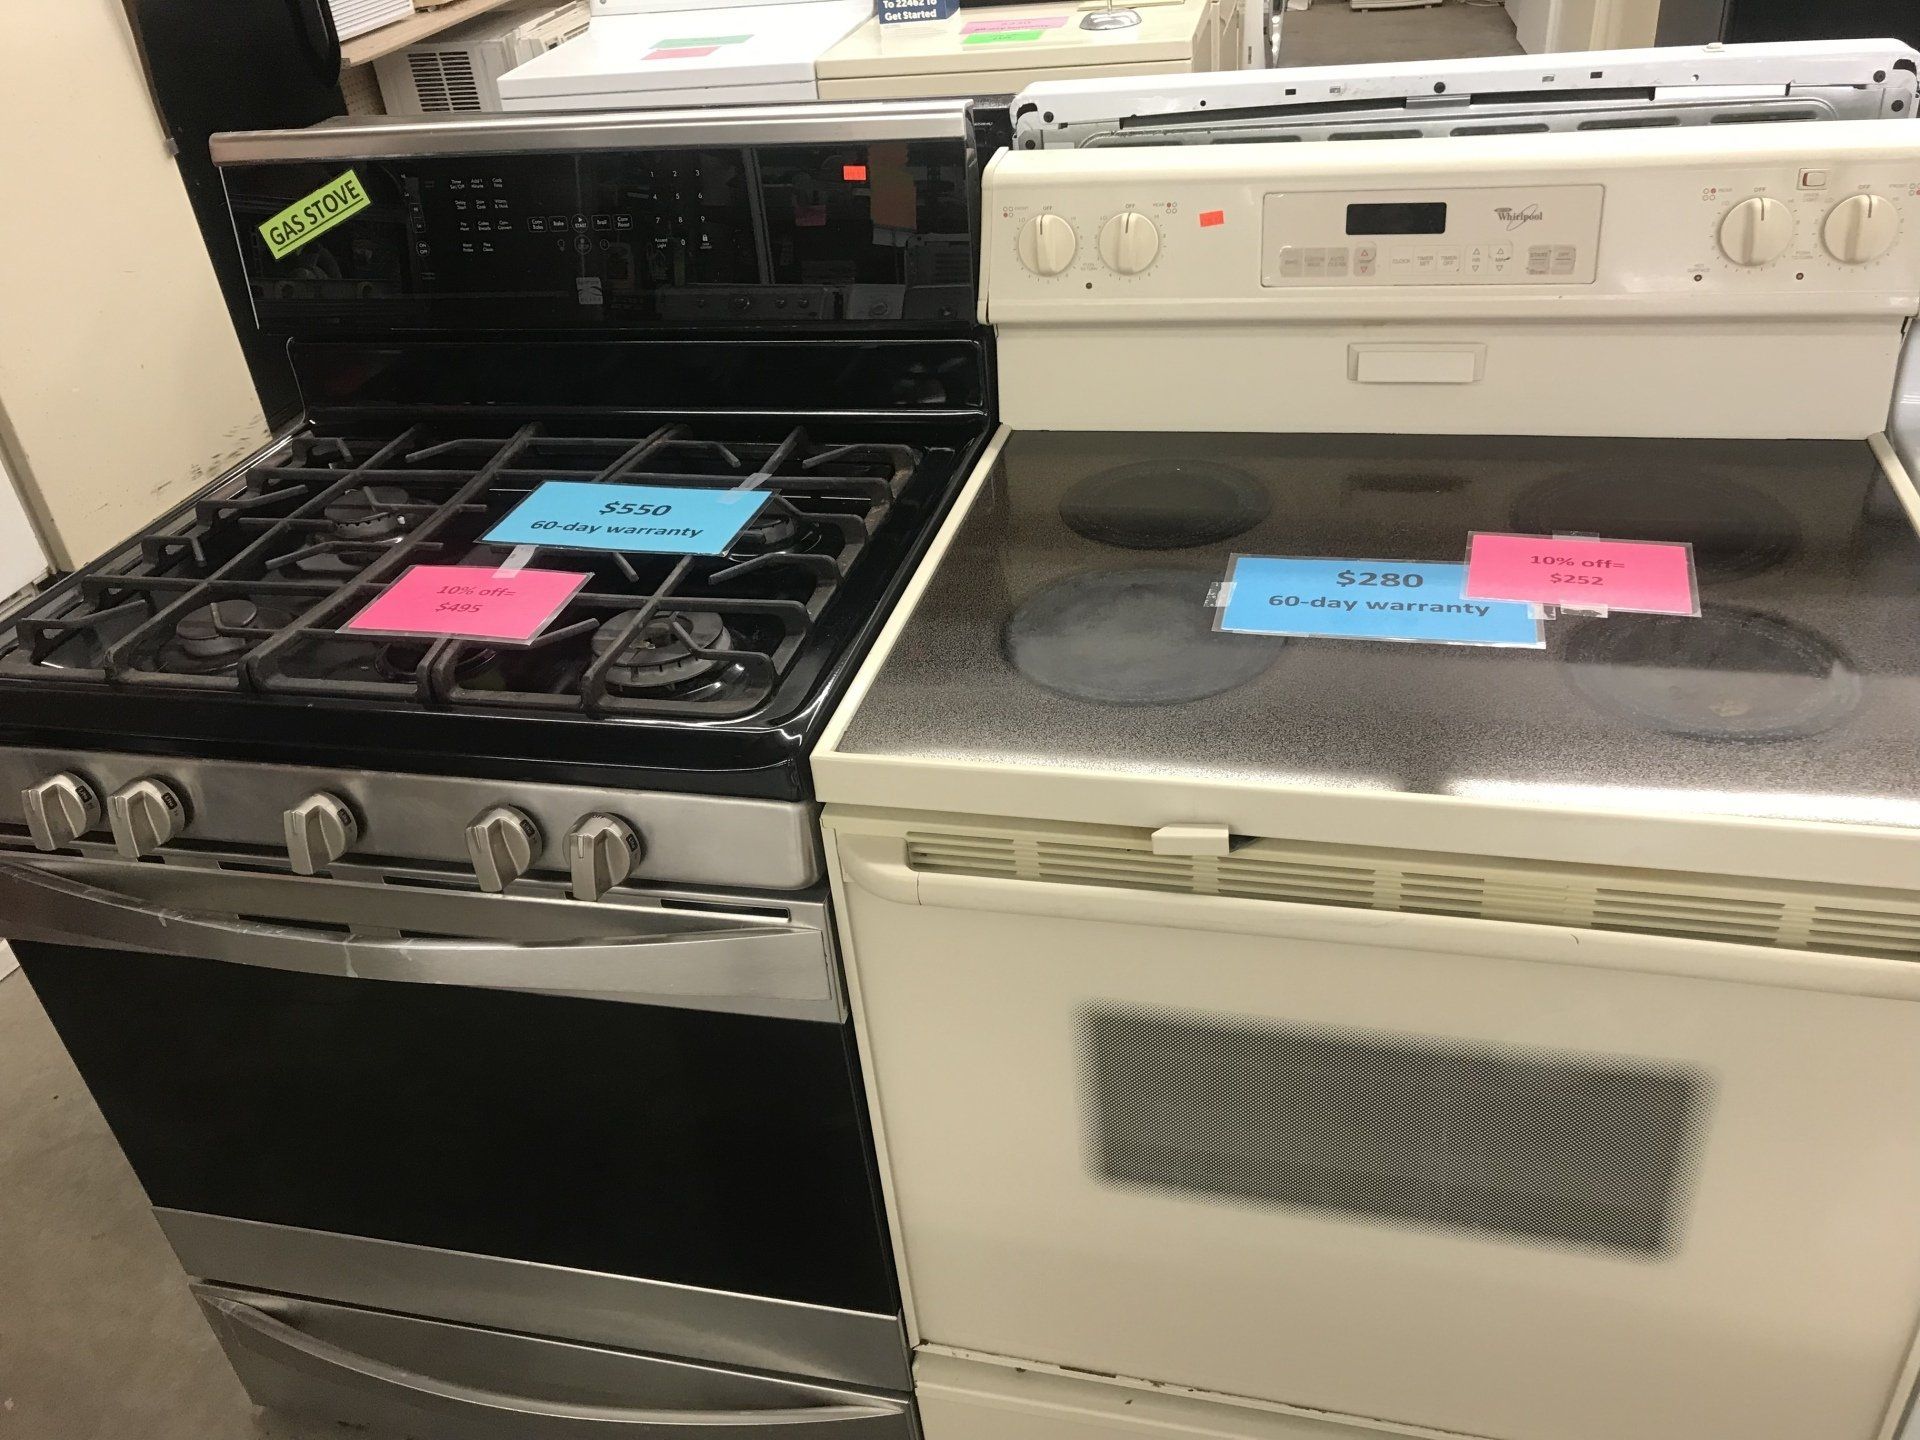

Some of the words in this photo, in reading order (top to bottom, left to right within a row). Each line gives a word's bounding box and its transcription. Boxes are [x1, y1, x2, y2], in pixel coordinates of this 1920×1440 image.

[883, 0, 895, 8] To
[885, 12, 902, 21] Get
[903, 9, 937, 20] Started
[269, 214, 306, 246] GAS
[303, 179, 361, 226] STOVE
[1497, 211, 1543, 223] Whirlpool
[599, 500, 673, 517] $550
[530, 519, 602, 535] 60-day
[606, 524, 703, 540] warranty
[1529, 555, 1575, 567] 10%
[1581, 557, 1626, 569] off=
[1336, 569, 1424, 589] $280
[1549, 572, 1605, 587] $252
[435, 585, 477, 596] 10%
[434, 601, 484, 613] $495
[1268, 595, 1359, 613] 60-day
[1366, 602, 1490, 618] warranty
